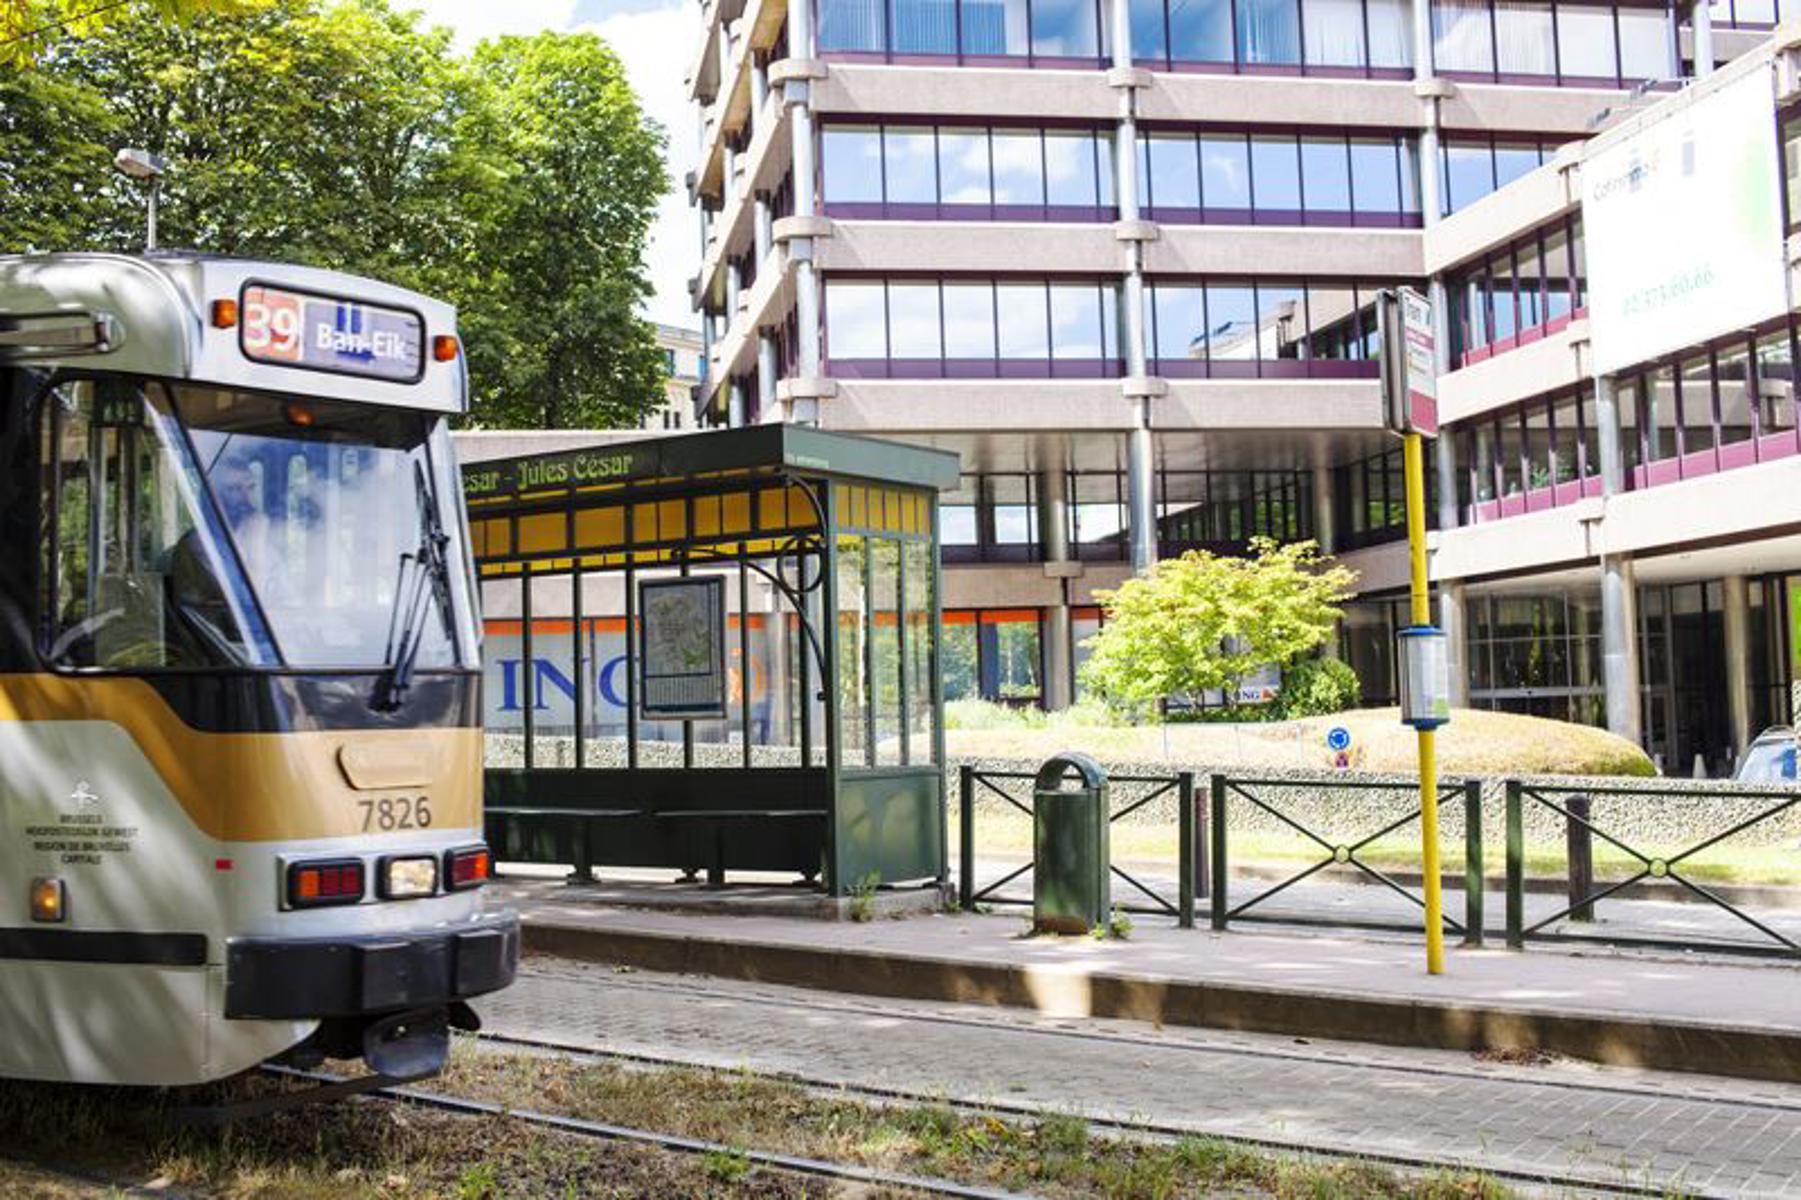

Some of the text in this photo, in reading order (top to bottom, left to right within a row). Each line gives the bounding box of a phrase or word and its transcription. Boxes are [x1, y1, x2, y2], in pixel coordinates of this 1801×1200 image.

[244, 303, 297, 351] 39
[517, 460, 568, 490] Jules
[574, 454, 632, 478] César
[358, 796, 431, 833] 7826
